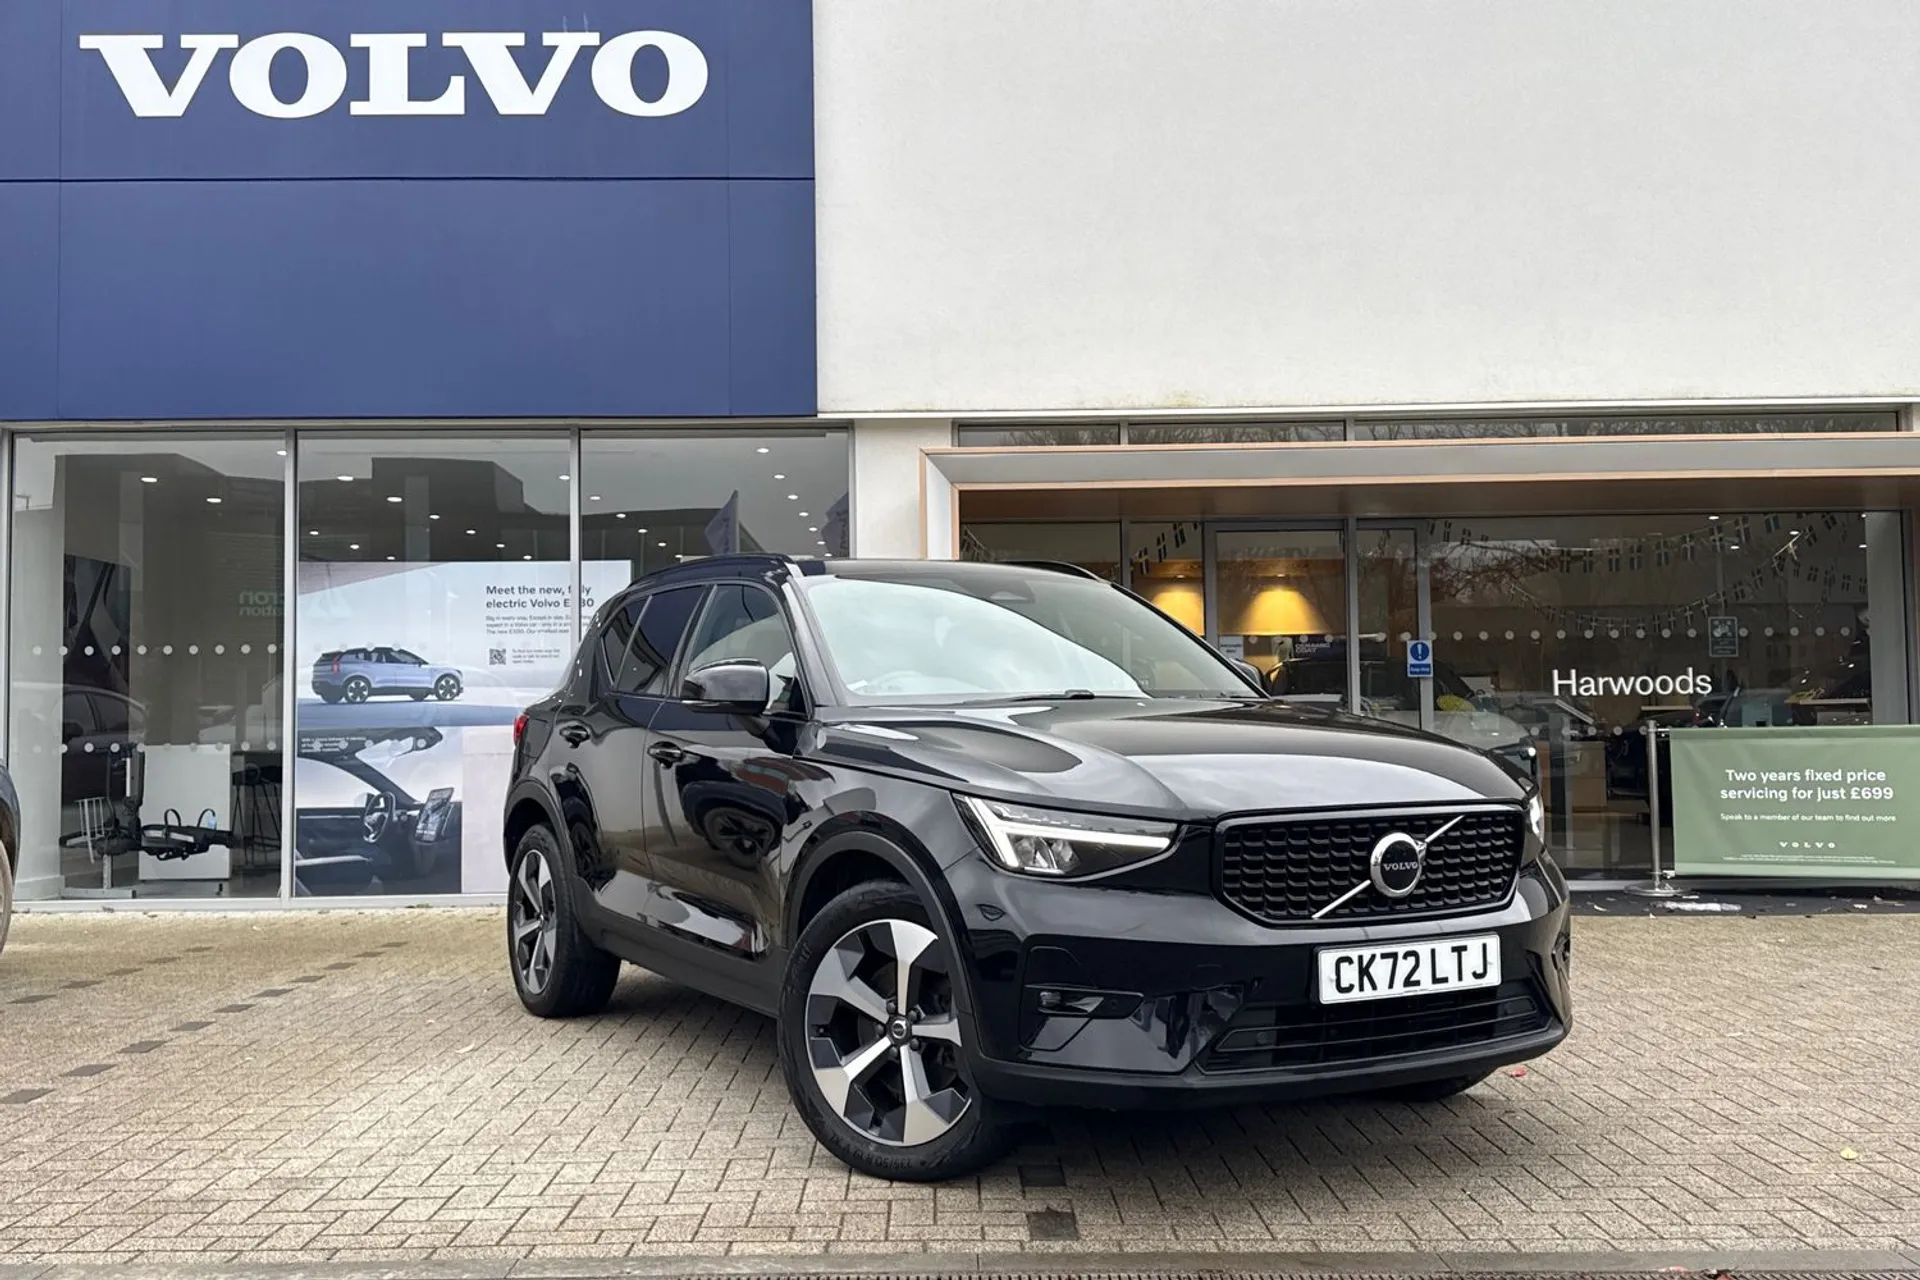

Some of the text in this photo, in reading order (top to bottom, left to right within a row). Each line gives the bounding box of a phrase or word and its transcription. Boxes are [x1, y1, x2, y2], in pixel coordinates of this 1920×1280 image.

[79, 30, 709, 119] VOLVO
[486, 586, 515, 595] Meet
[518, 585, 537, 595] the
[539, 587, 565, 596] new,
[486, 597, 595, 609] electric Volvo E30
[1552, 667, 1713, 697] Harwoods
[1725, 768, 1886, 784] Two years fixed price
[1720, 786, 1894, 802] servicing for just £699
[1720, 812, 1742, 822] Speak
[1760, 812, 1790, 820] member
[1845, 813, 1860, 821] find
[1861, 813, 1875, 822] out
[1779, 841, 1835, 849] VOLVO
[1383, 861, 1418, 871] VOLVO
[1335, 942, 1488, 994] CK72 LTJ
